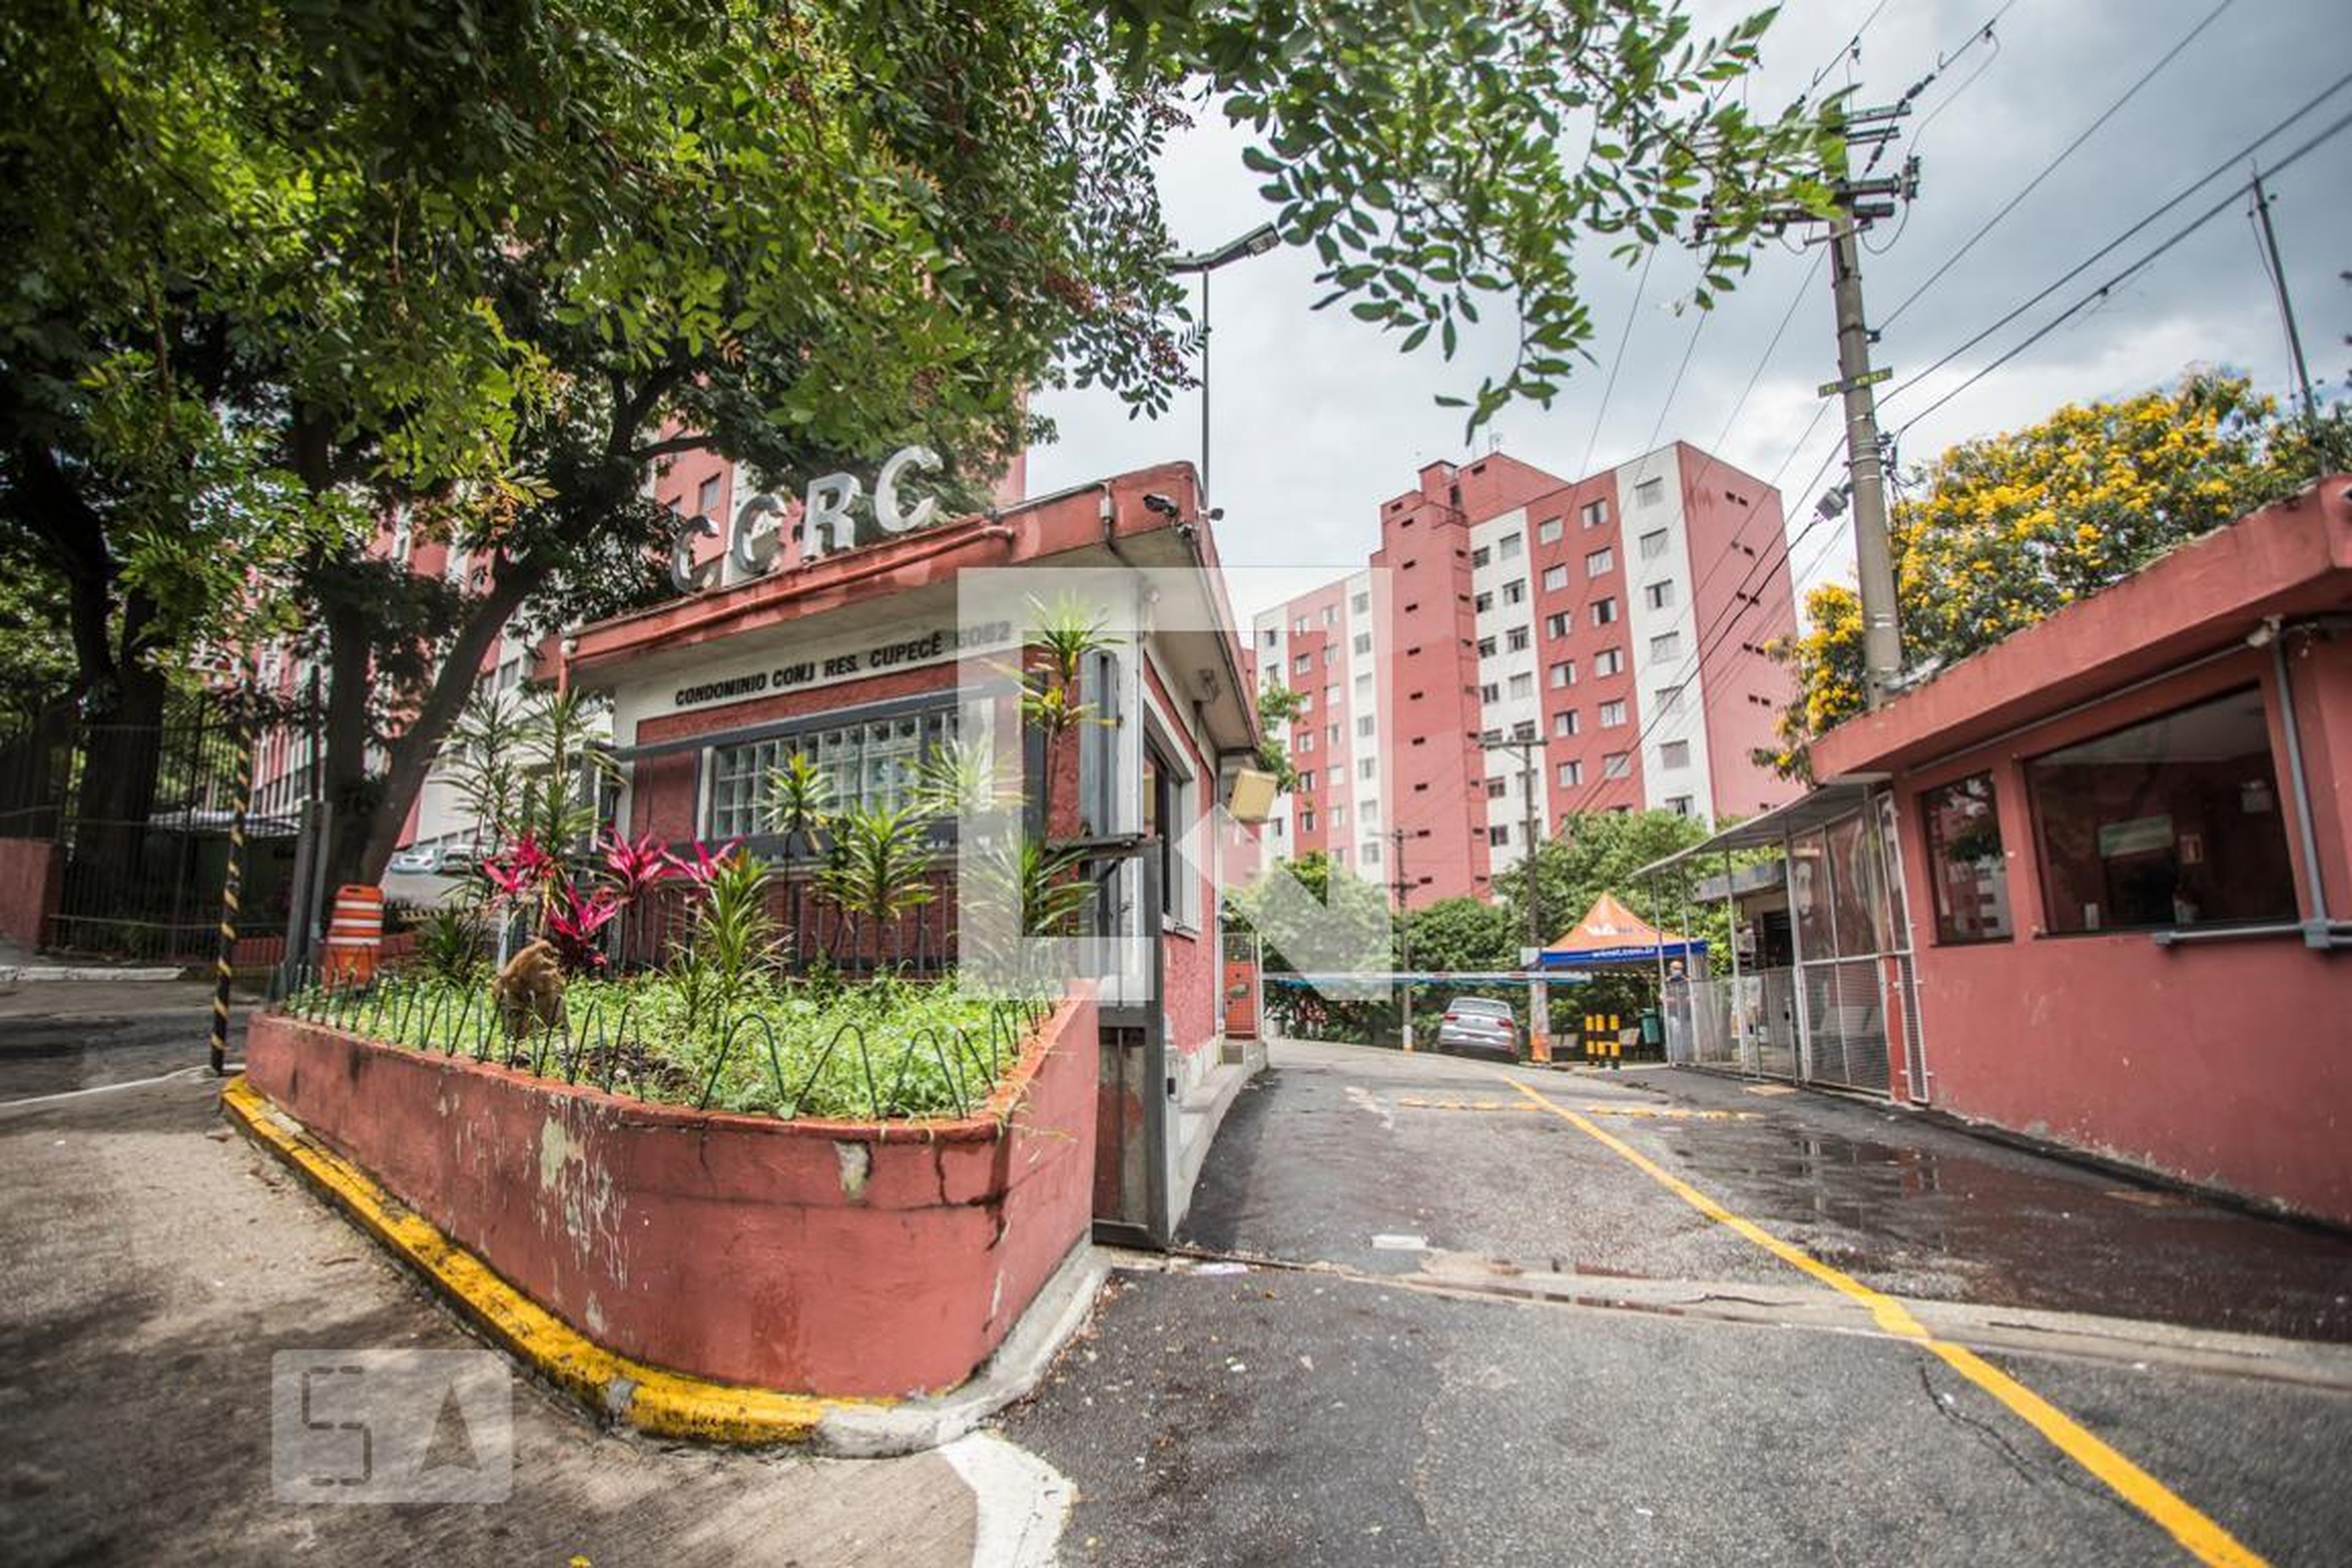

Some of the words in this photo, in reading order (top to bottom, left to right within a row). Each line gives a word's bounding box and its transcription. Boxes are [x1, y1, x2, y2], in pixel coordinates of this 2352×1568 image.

[675, 673, 766, 706] CONDOMINIO
[772, 662, 815, 687] CONJ
[824, 654, 859, 676] RES.
[869, 631, 942, 668] CUPECÊ
